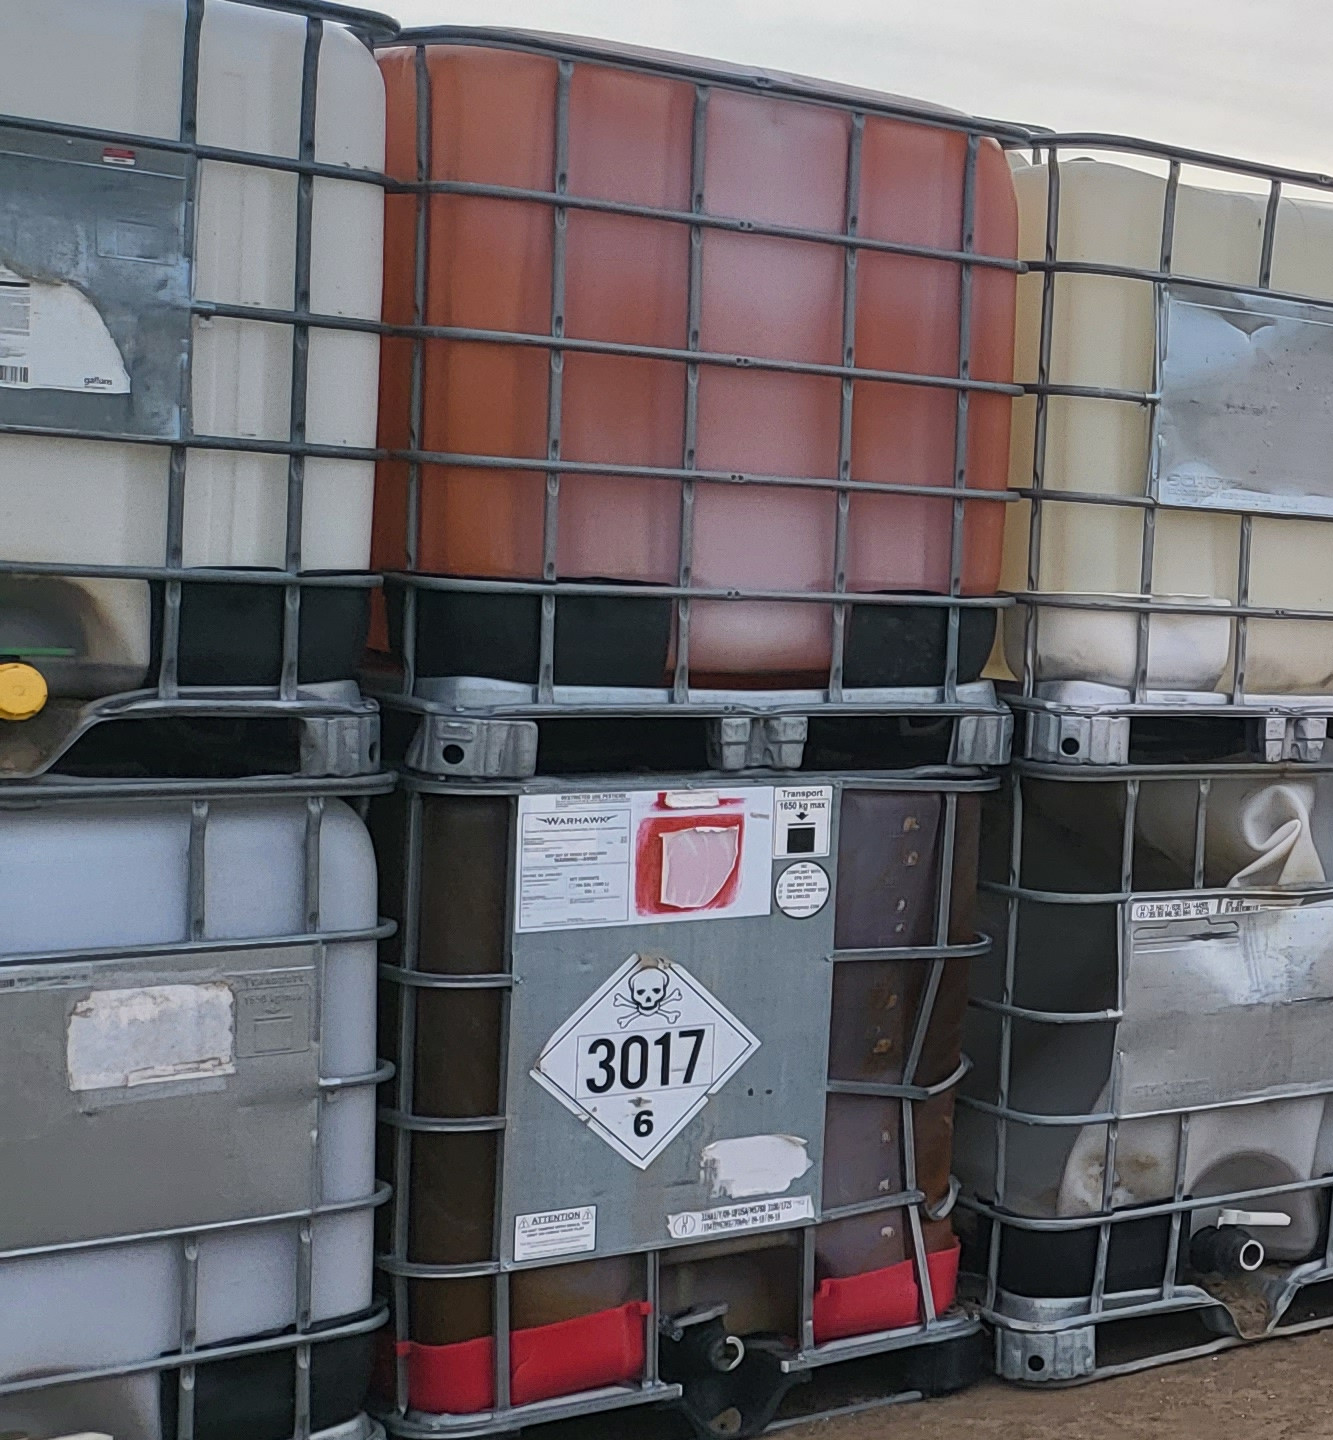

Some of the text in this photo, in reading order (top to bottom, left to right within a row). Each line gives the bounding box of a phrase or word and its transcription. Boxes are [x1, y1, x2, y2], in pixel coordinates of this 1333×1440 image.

[782, 790, 823, 799] Transport
[780, 802, 797, 810] 1650
[798, 802, 808, 811] kg
[547, 816, 608, 825] WARHAWK
[586, 1029, 705, 1093] 3017
[634, 1110, 654, 1137] 6
[531, 1211, 580, 1225] ATTENTION
